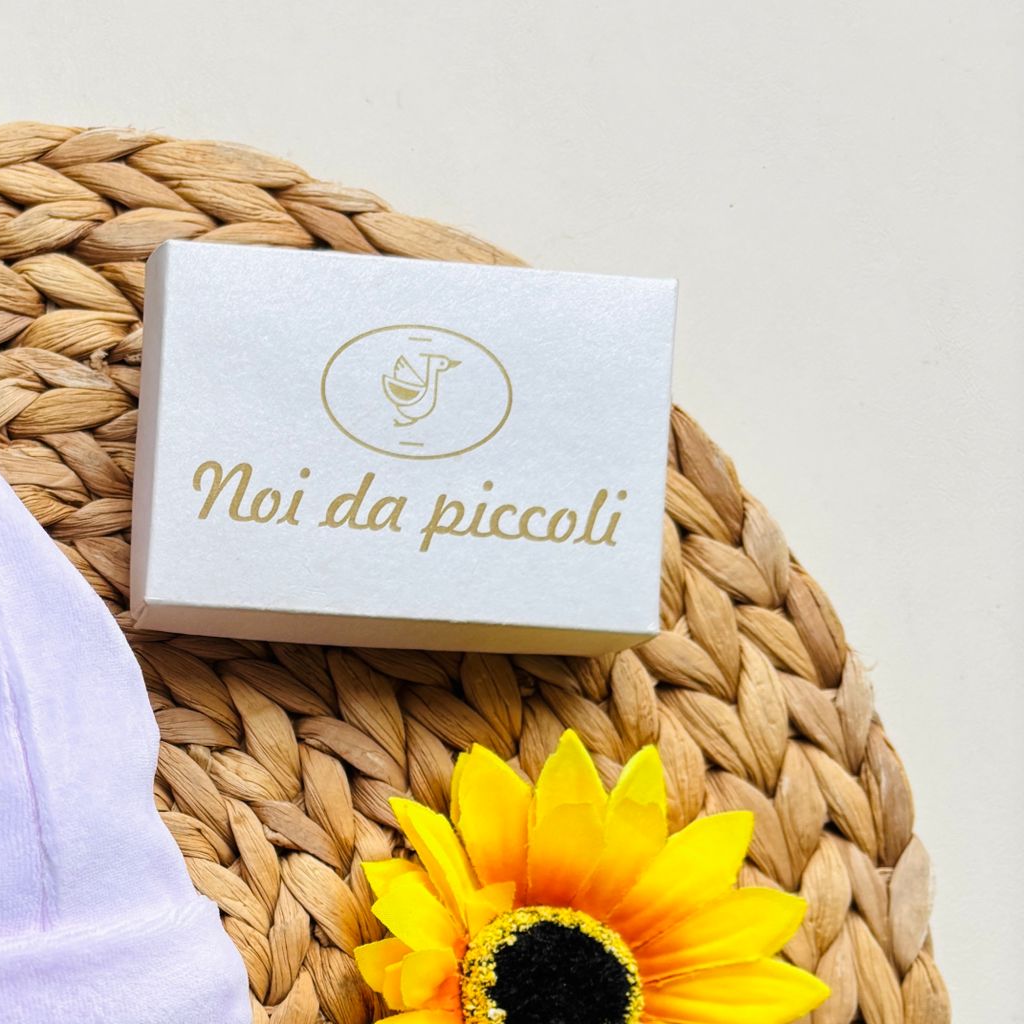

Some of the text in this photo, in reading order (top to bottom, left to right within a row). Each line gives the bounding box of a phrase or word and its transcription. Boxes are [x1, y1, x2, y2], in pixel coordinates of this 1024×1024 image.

[191, 459, 628, 553] Noi da piccoli
